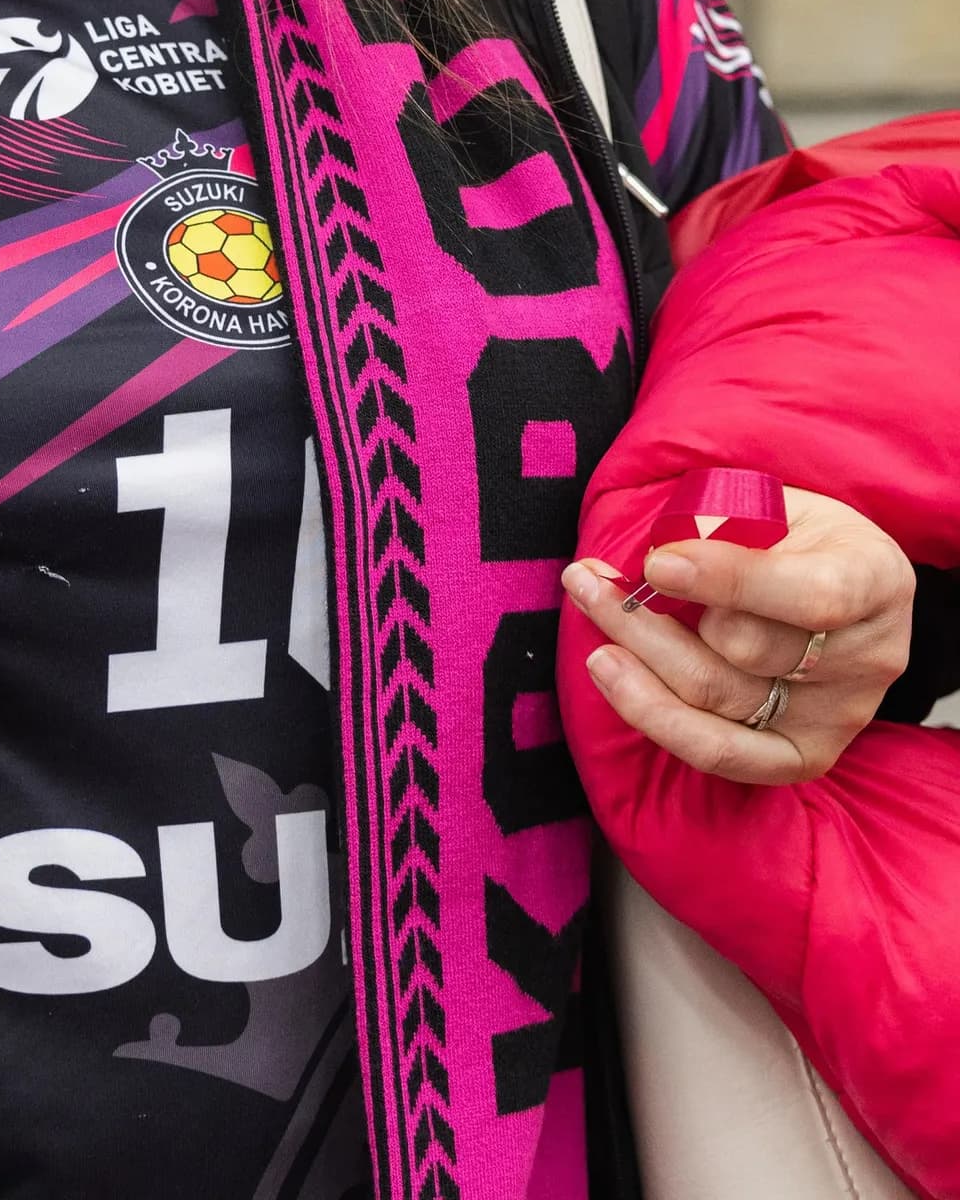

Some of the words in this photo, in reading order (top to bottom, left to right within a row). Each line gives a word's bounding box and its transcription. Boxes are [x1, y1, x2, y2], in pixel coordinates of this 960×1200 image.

[84, 13, 161, 44] LIGA
[99, 37, 230, 73] CENTRA
[112, 69, 226, 96] KOBIET
[164, 183, 245, 212] SUZUKI
[150, 276, 243, 334] KORONA
